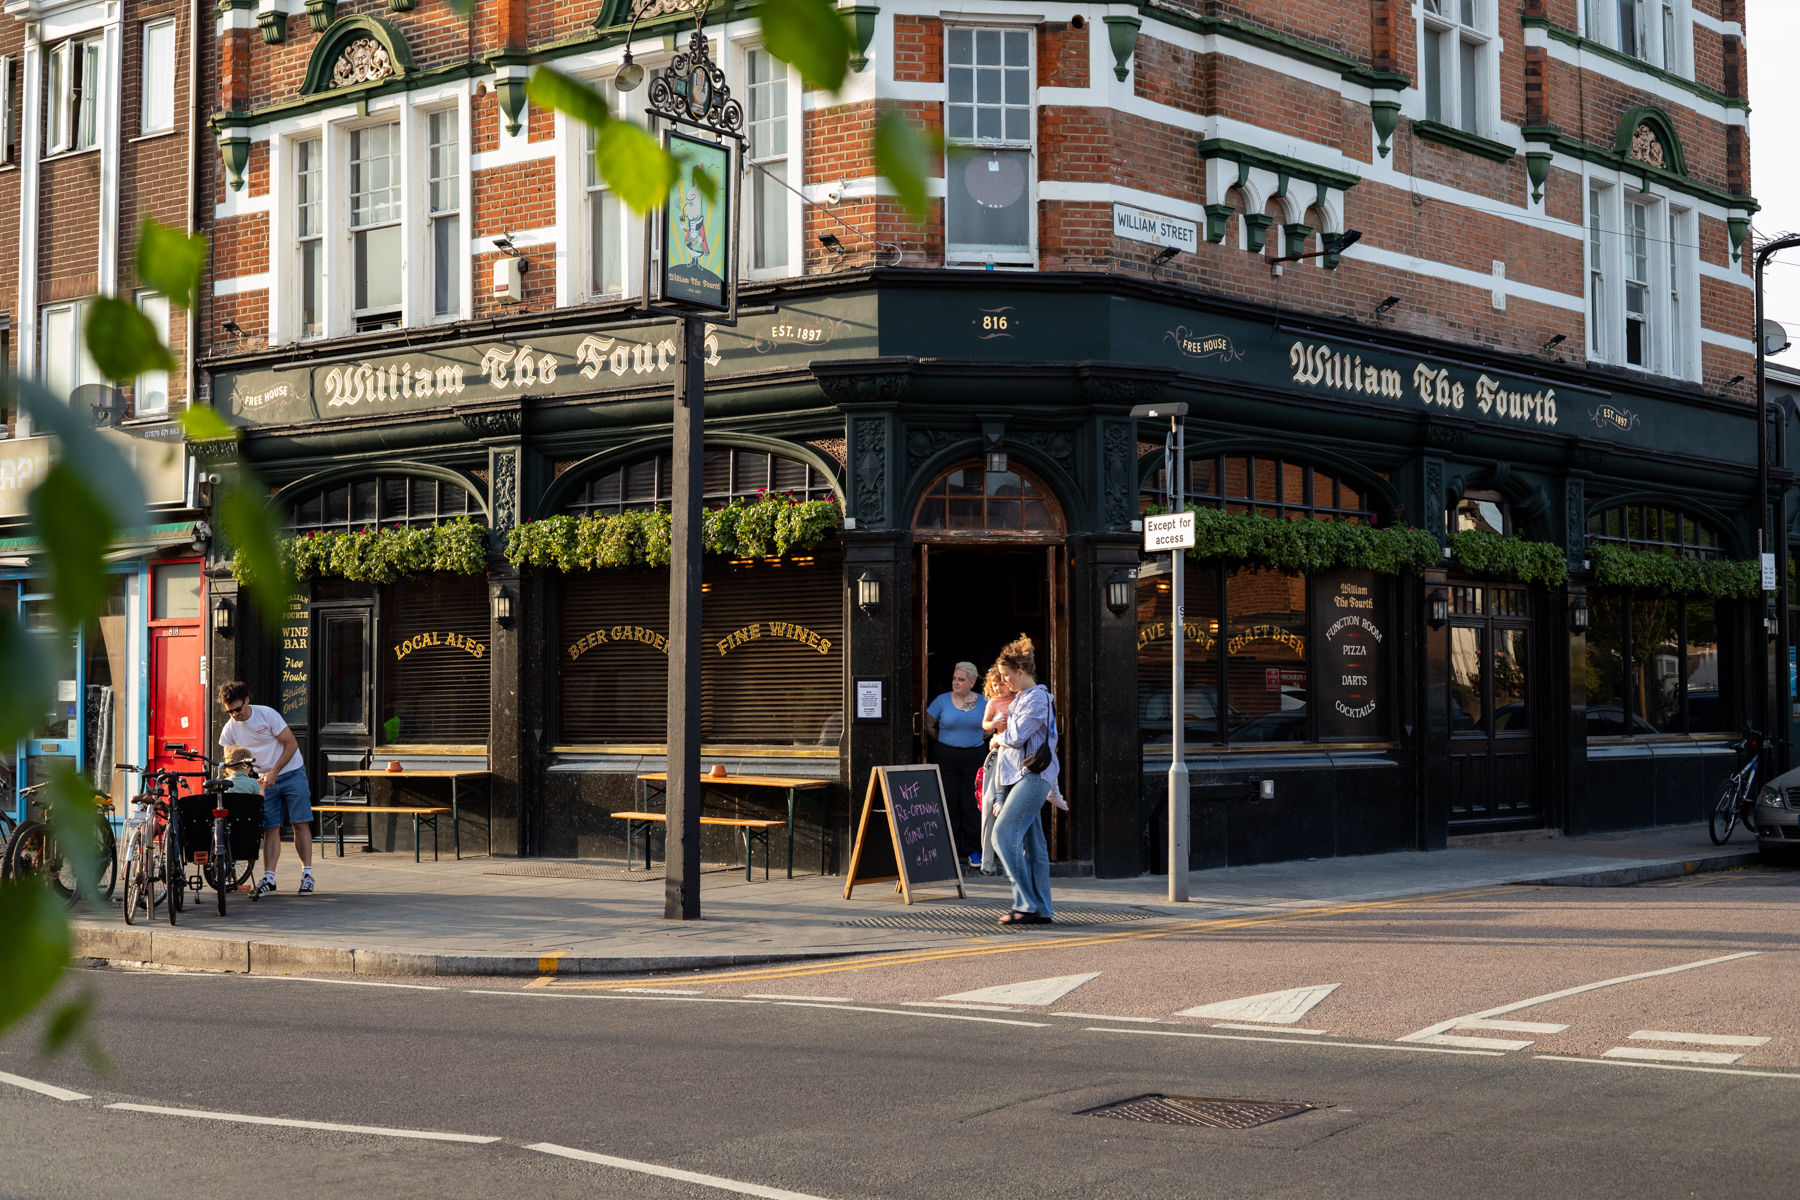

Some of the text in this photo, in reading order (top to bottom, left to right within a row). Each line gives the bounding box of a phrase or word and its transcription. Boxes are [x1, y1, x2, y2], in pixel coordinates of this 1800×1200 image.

[1138, 211, 1154, 219] BOROUGH
[1160, 216, 1173, 224] LEYTON
[1117, 212, 1194, 242] WILLIAM STREET
[668, 273, 721, 290] William The Fourth
[982, 315, 1008, 330] 816
[771, 325, 822, 341] EST. 1897
[1182, 338, 1227, 353] FREE HOUSE
[324, 323, 722, 407] William The Fourh
[1289, 341, 1558, 426] William The Fourth
[244, 385, 288, 406] FREE HOUSE
[1603, 408, 1628, 427] EST. 1897
[1148, 517, 1191, 532] Except for
[1155, 534, 1184, 545] access
[1340, 582, 1368, 596] William
[284, 594, 309, 604] ILLIAM
[1333, 595, 1374, 609] The Fourth
[282, 611, 309, 619] FOURTH
[281, 626, 309, 637] WINE
[1325, 615, 1383, 643] FUNCTION ROOM
[283, 638, 308, 650] BAR
[716, 621, 832, 657] FINE WINES
[1137, 622, 1216, 652] LIVE ORT
[1228, 624, 1305, 659] CRAFT BEER
[394, 631, 486, 660] LOCAL ALES
[568, 629, 609, 661] BEER
[1342, 644, 1367, 656] PIZZA
[285, 656, 304, 668] Free
[282, 670, 308, 682] House
[1341, 675, 1368, 686] DARTS
[1335, 700, 1376, 718] COCKTAILS
[903, 826, 924, 845] JUNE
